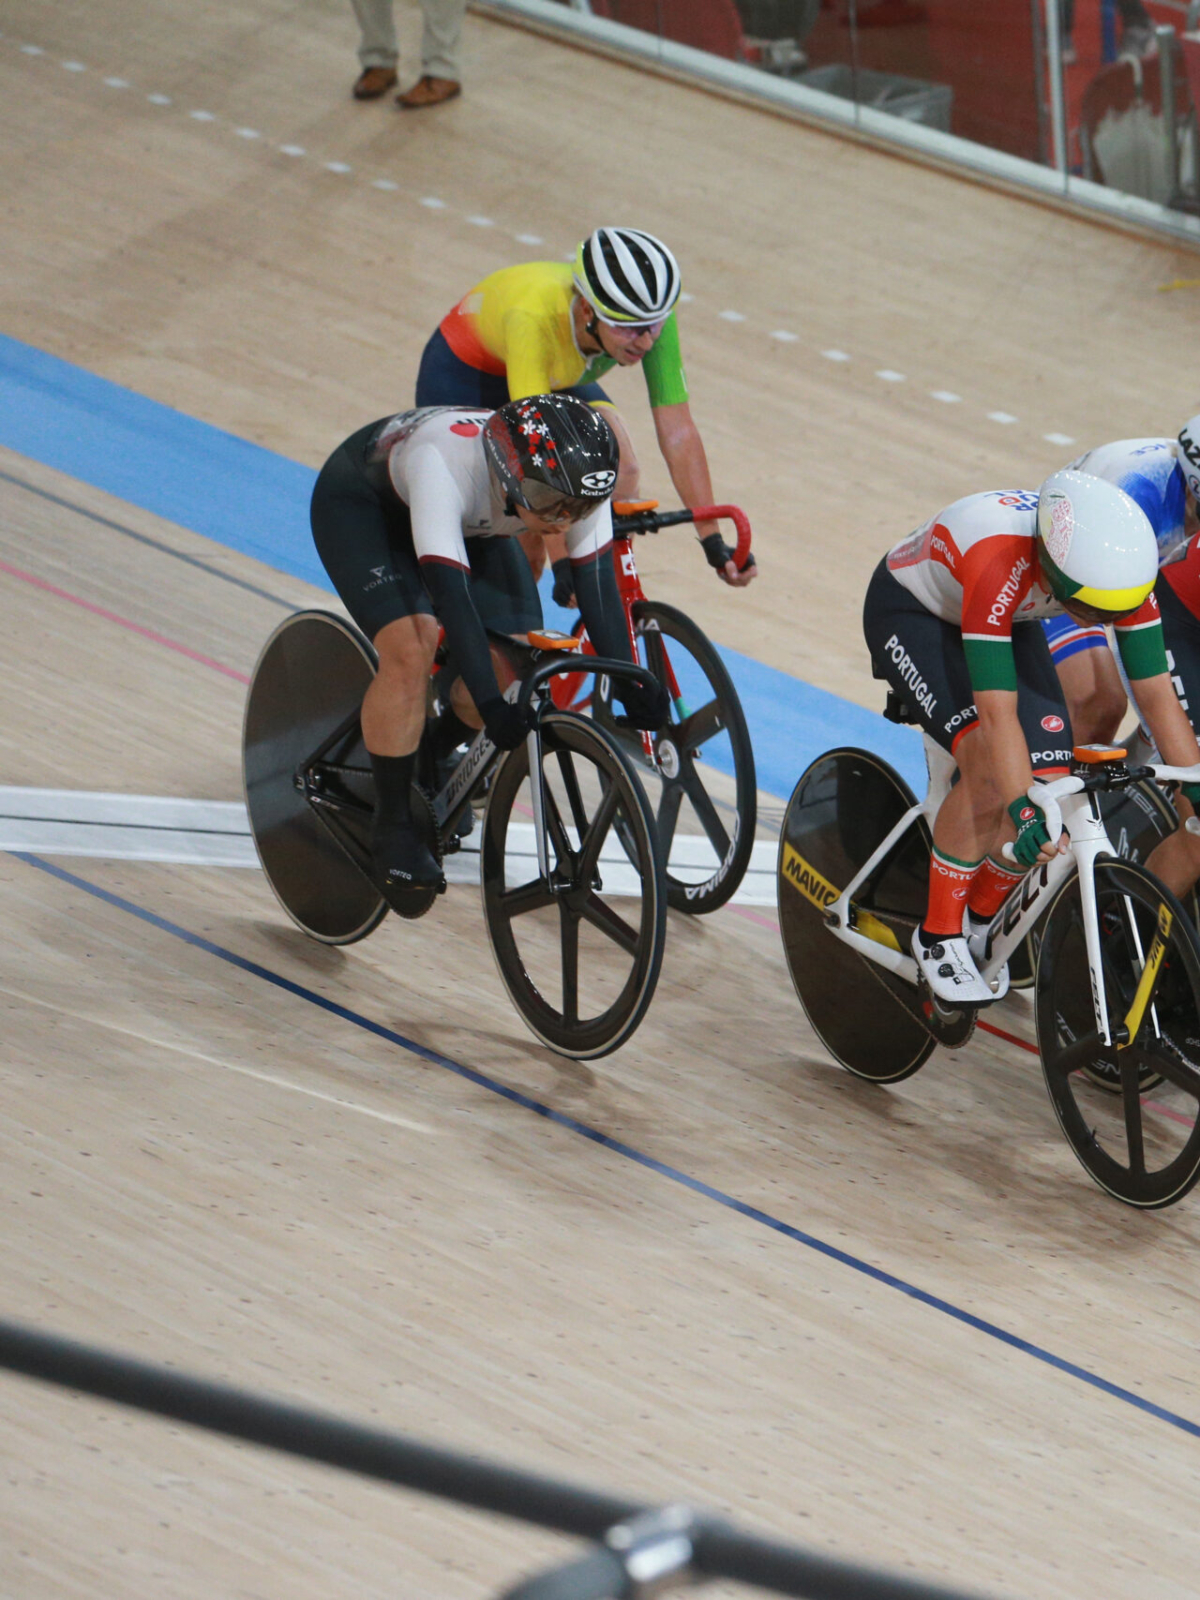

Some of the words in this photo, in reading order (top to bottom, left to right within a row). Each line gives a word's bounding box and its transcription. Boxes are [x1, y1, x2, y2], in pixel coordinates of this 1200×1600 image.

[931, 535, 957, 569] PORTUGAL
[987, 557, 1031, 627] PORTUGAL
[884, 634, 937, 719] PORTUGAL
[786, 857, 836, 907] MAVIC
[985, 863, 1048, 960] FELT
